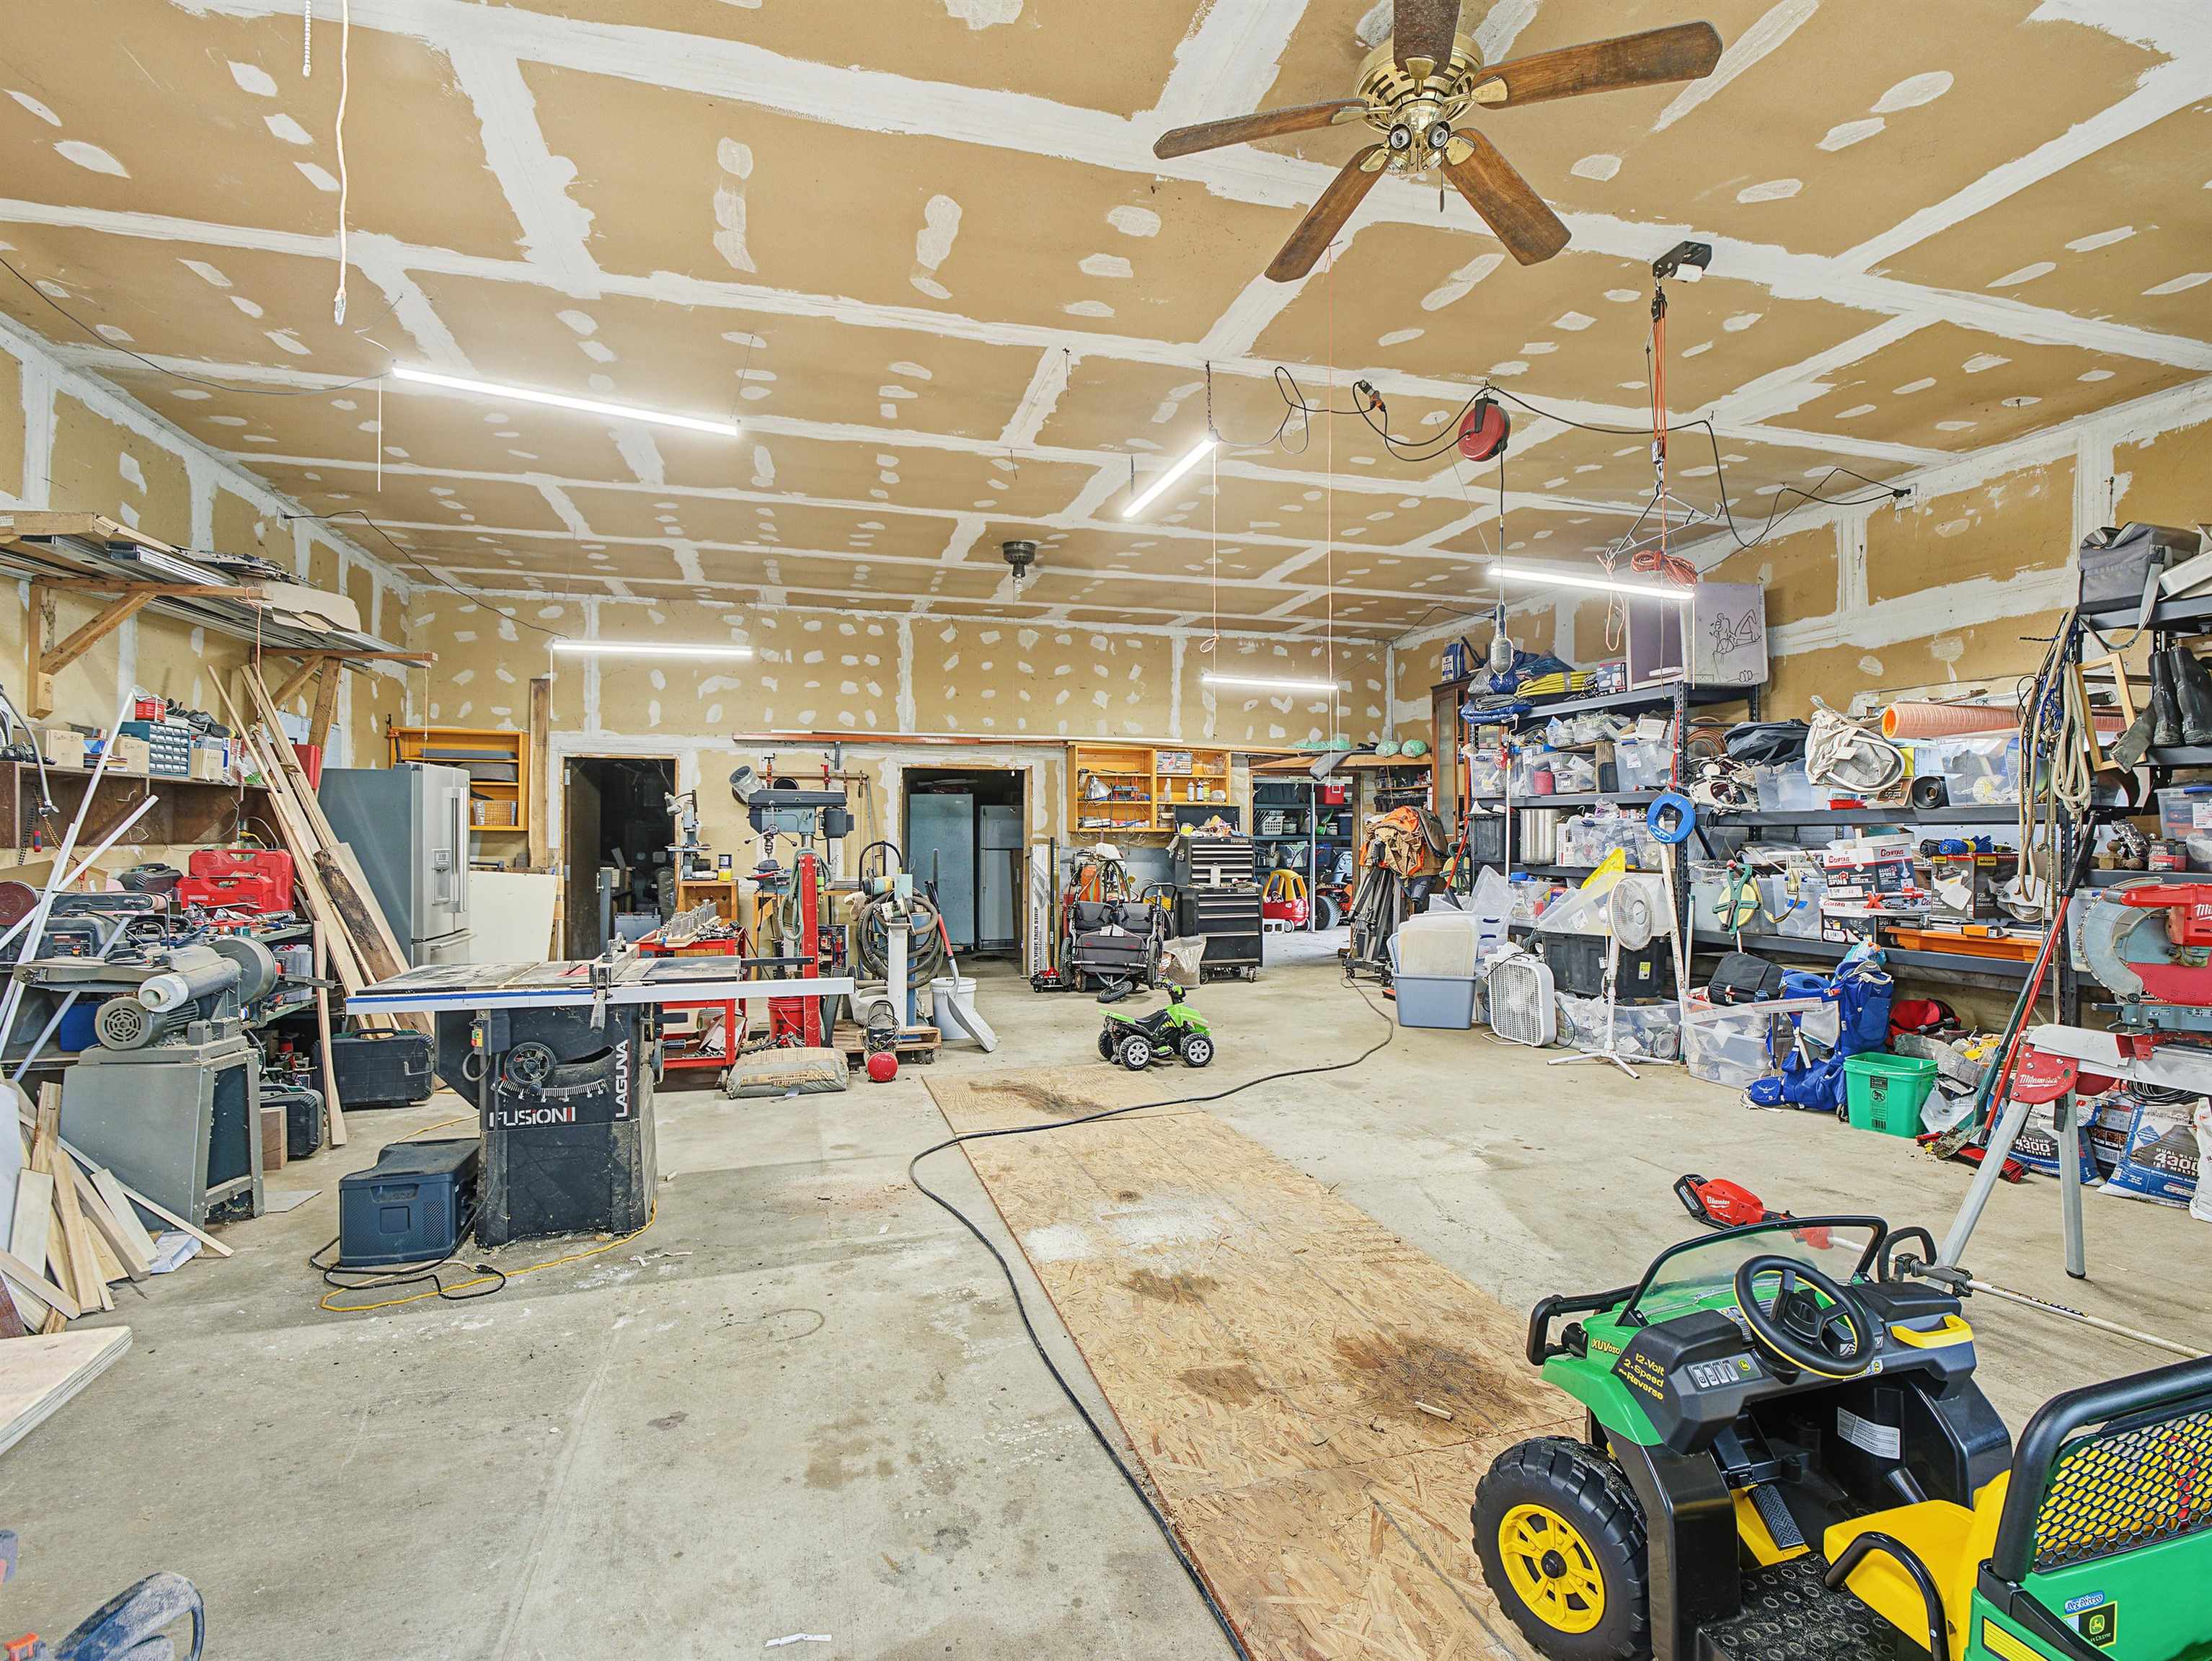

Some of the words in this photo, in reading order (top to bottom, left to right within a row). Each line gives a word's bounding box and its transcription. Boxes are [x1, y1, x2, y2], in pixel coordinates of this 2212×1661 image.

[615, 1039, 629, 1118] LAGUNA
[2015, 1138, 2050, 1153] 4300
[2179, 1153, 2198, 1161] BLEN
[2169, 1166, 2198, 1176] MELTE
[1627, 1371, 1664, 1400] Reverse
